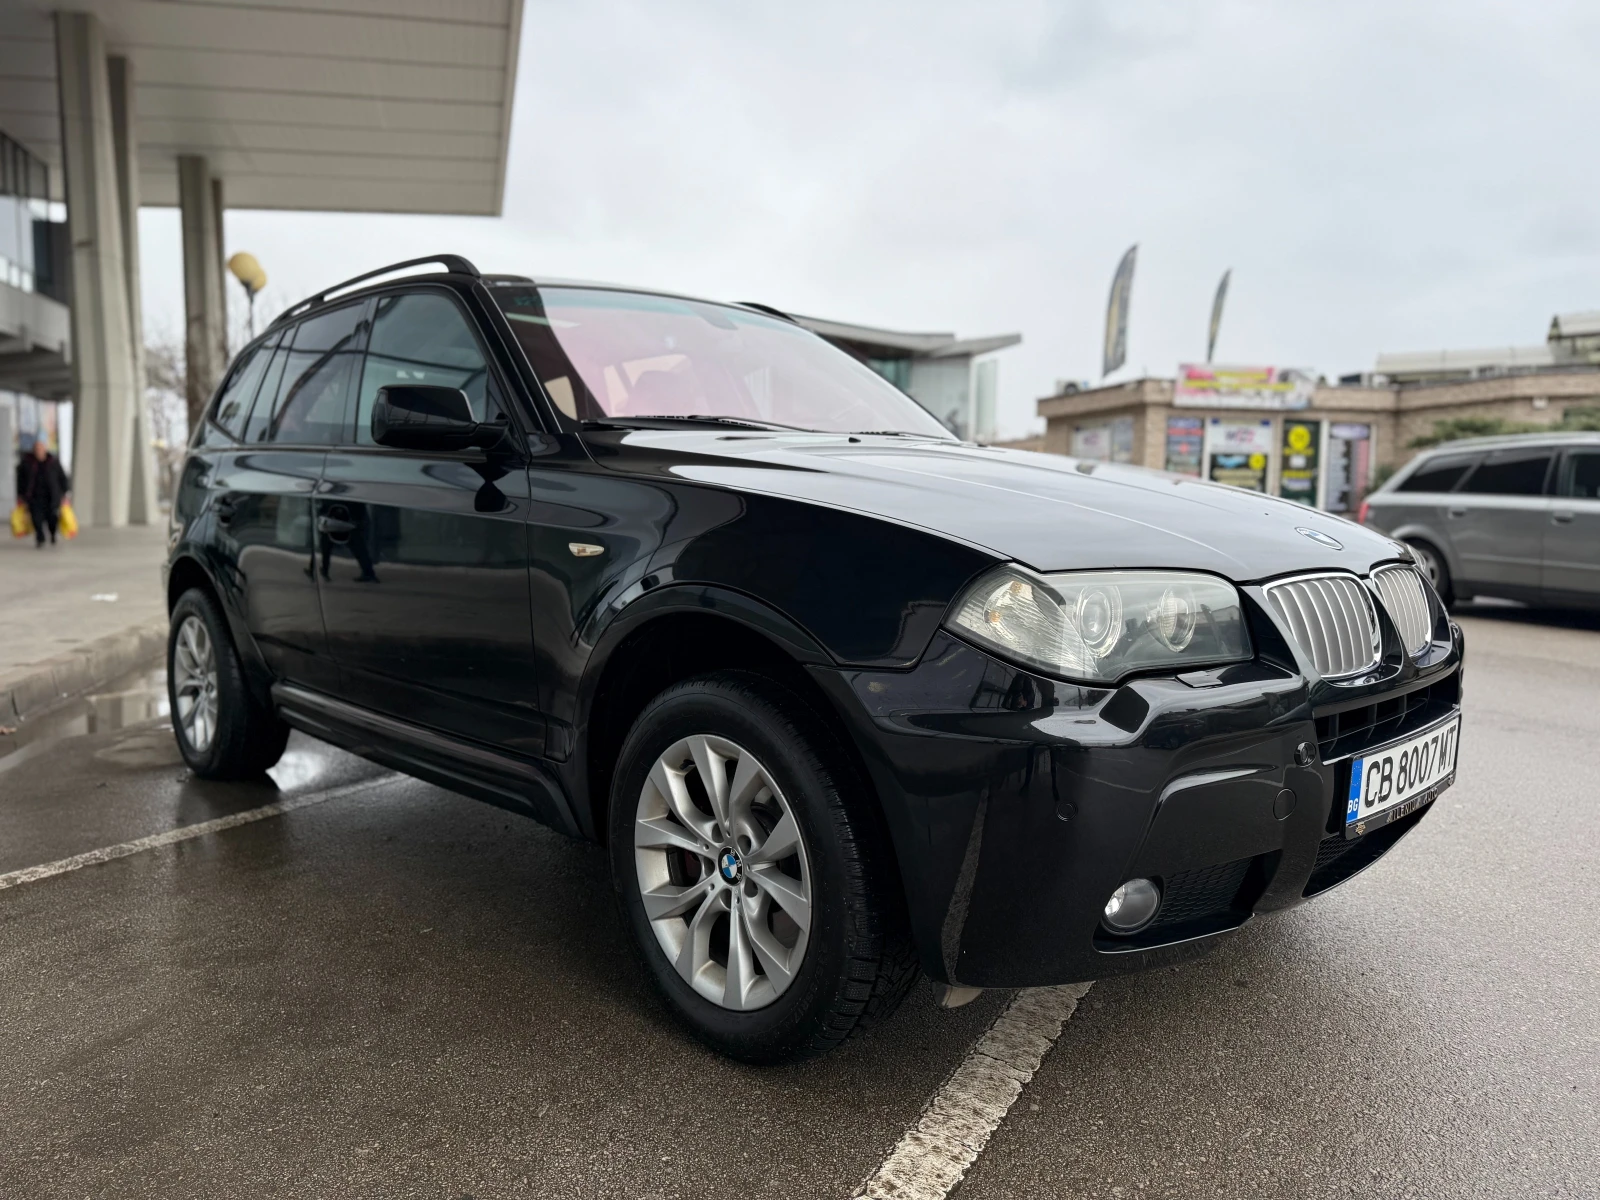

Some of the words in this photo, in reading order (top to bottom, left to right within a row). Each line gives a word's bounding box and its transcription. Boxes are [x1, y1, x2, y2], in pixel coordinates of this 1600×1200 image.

[1364, 756, 1394, 808] CB
[1396, 735, 1439, 795] 8007
[1437, 724, 1457, 774] MT
[1347, 798, 1359, 813] BG
